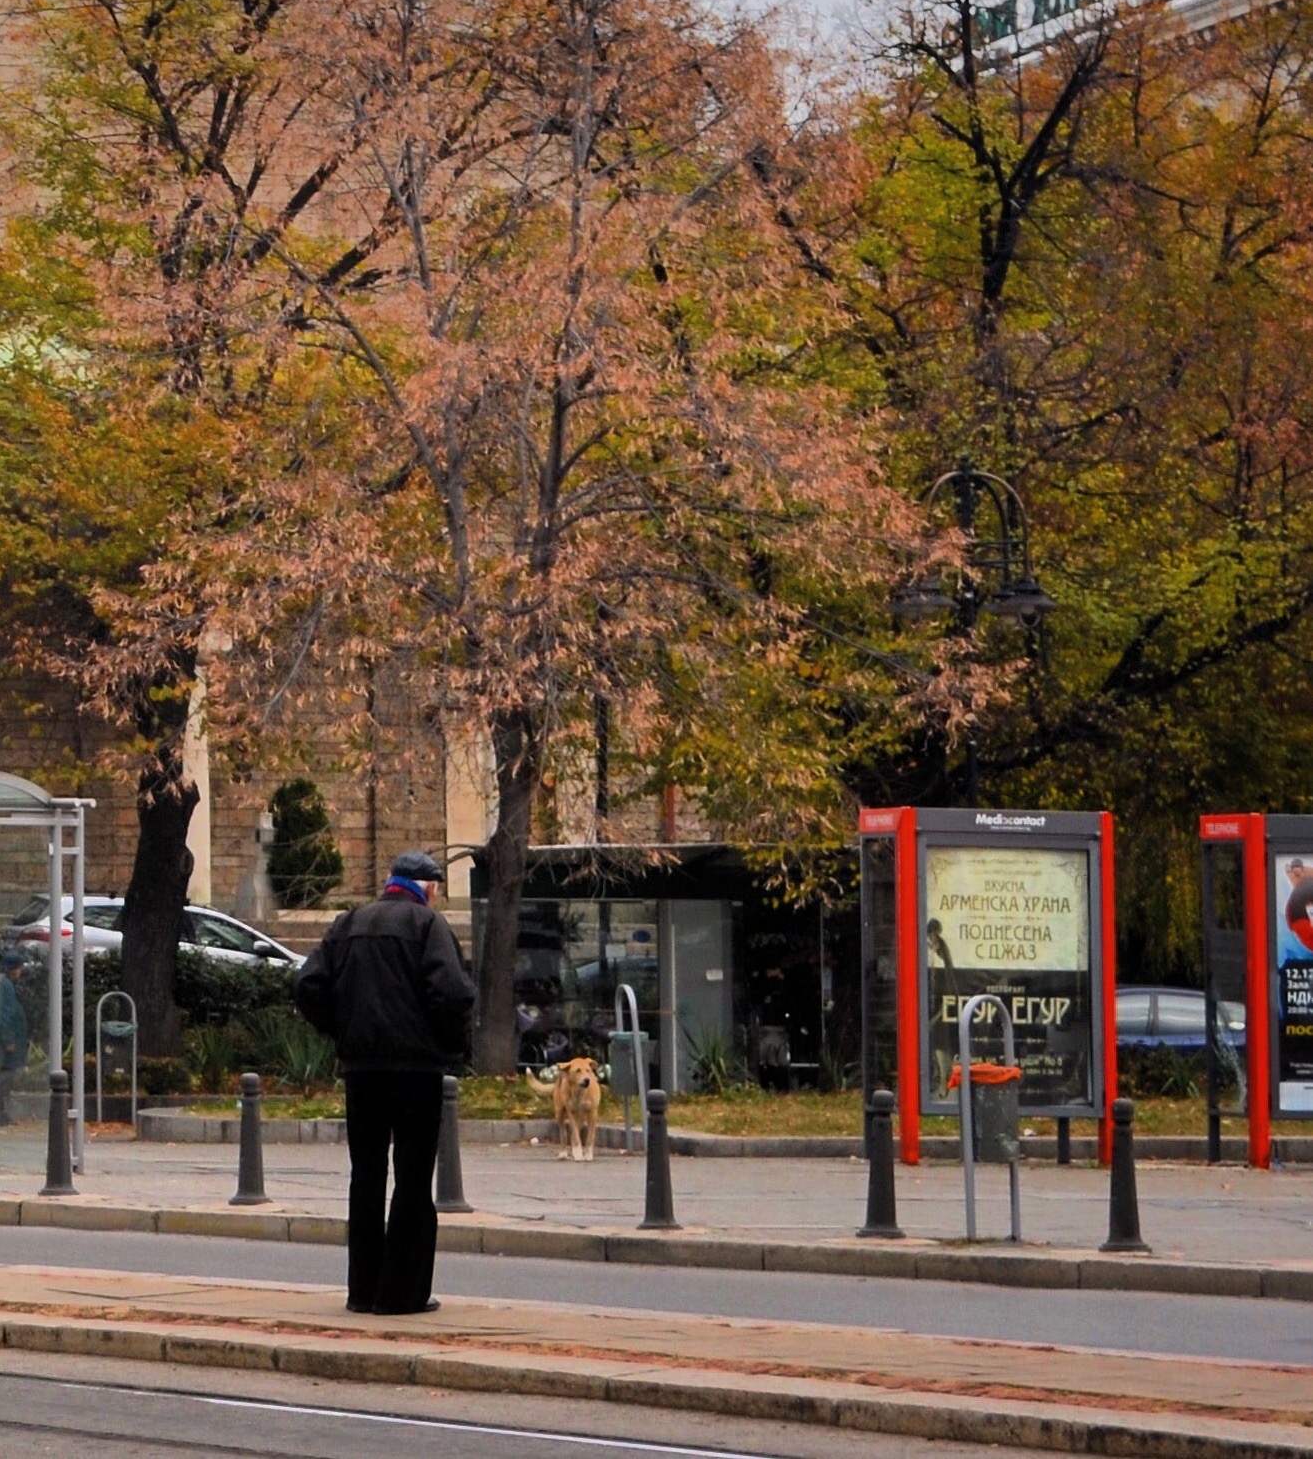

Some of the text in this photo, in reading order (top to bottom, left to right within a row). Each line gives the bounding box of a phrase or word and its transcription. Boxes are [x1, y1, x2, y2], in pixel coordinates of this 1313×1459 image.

[984, 880, 1025, 891] ВКУСНА
[939, 894, 1071, 913] АРМЕНСКА ХРАНА
[959, 923, 1052, 941] ПОДНЕСЕНА
[975, 943, 1037, 960] С ДЖАЗ
[1012, 997, 1071, 1025] ЕГУР
